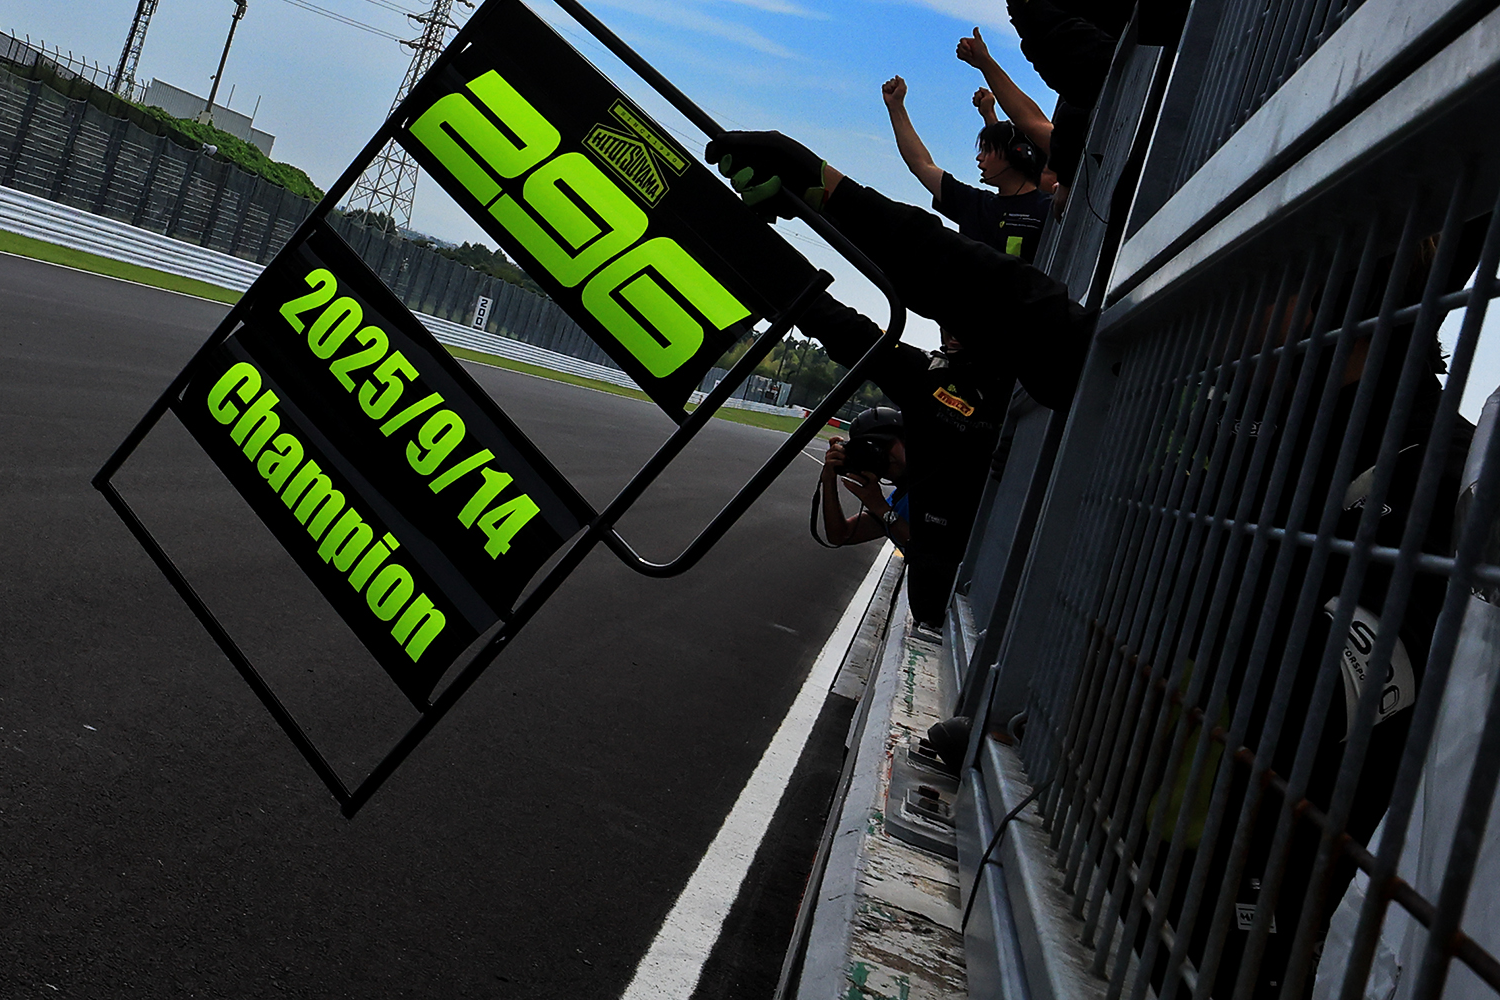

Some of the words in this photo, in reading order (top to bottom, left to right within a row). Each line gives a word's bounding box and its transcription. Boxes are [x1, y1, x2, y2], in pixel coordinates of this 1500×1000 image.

[408, 69, 752, 378] 296
[591, 131, 660, 198] HITOTSUYAMA
[278, 267, 541, 560] 2025/9/14
[475, 298, 488, 326] 200
[207, 361, 447, 663] Champion
